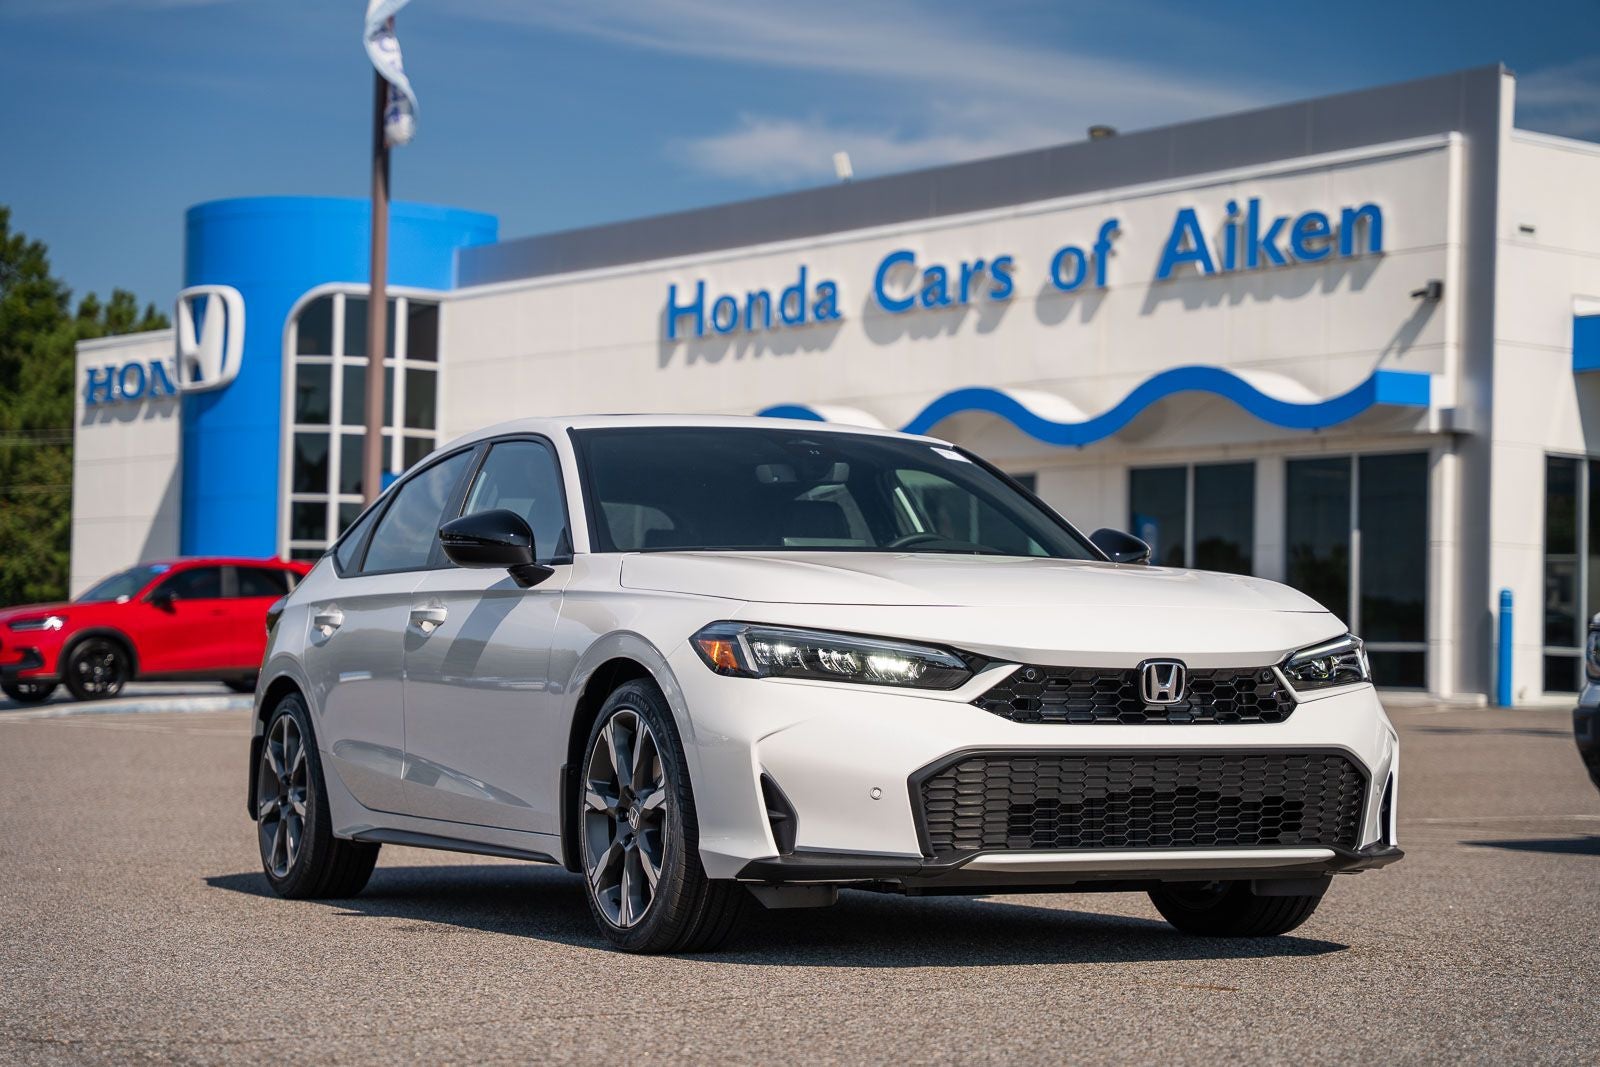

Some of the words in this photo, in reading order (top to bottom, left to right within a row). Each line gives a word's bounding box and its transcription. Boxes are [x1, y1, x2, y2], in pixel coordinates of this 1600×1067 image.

[667, 265, 841, 341] Honda
[874, 250, 1014, 314] Cars
[1050, 218, 1119, 290] of
[1155, 198, 1383, 281] Aiken
